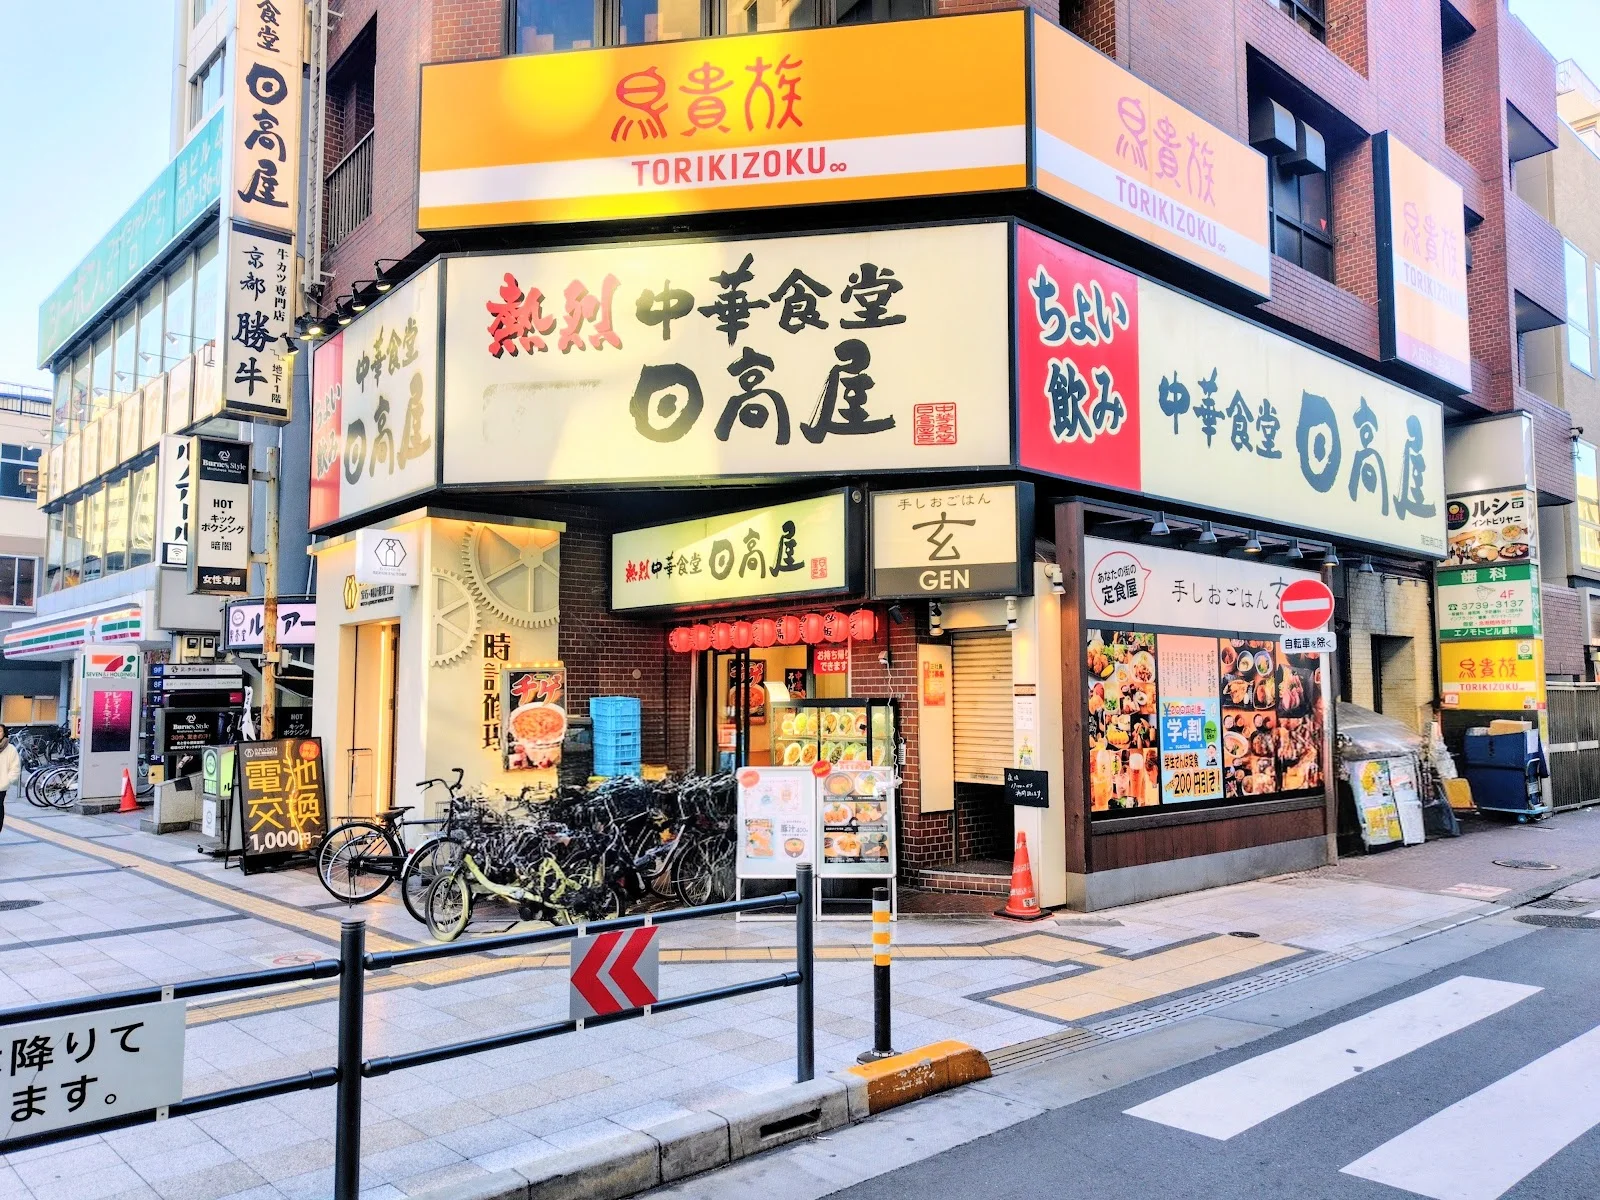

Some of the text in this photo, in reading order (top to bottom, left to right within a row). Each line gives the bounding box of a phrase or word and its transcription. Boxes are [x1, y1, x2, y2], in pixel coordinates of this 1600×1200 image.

[257, 0, 280, 52] 食堂
[610, 53, 804, 142] 鳥貴族
[237, 62, 288, 208] 日高屋
[1115, 96, 1216, 208] 鳥貴族
[631, 146, 827, 187] TORIKIZOKU
[1115, 175, 1218, 248] TORIKIZOKU
[1403, 201, 1460, 281] 鳥貴族
[484, 252, 907, 359] 熱烈 中華食堂
[1029, 264, 1131, 347] ちょい
[356, 316, 418, 394] 中華食堂
[628, 338, 897, 446] 日高屋
[1045, 358, 1127, 443] 飲み
[343, 371, 432, 486] 日高屋
[1158, 366, 1437, 521] 中華食堂 日高屋
[210, 514, 236, 525] キック
[213, 498, 233, 509] HOT
[897, 492, 991, 511] 手しおごはん
[1471, 497, 1510, 518] ルシ
[201, 523, 245, 534] ボクシング
[210, 541, 232, 551] 暗闇
[911, 511, 977, 561] 玄
[651, 550, 703, 580] 中華食堂
[708, 519, 805, 581] 日高屋
[918, 568, 970, 591] GEN
[1101, 578, 1139, 606] 定食屋
[1171, 579, 1269, 610] 手しおごはん
[1460, 566, 1507, 584] 歯科
[1500, 589, 1515, 599] 4F
[1461, 600, 1524, 610] 3739-3137
[1284, 637, 1332, 650] 自転車を除く
[1459, 658, 1518, 679] 鳥貴族
[1460, 683, 1518, 691] TORIKIZOKU
[245, 758, 319, 793] 電池
[247, 793, 321, 832] 交換
[0, 1022, 145, 1077] 降りて
[10, 1074, 117, 1122] ます。
